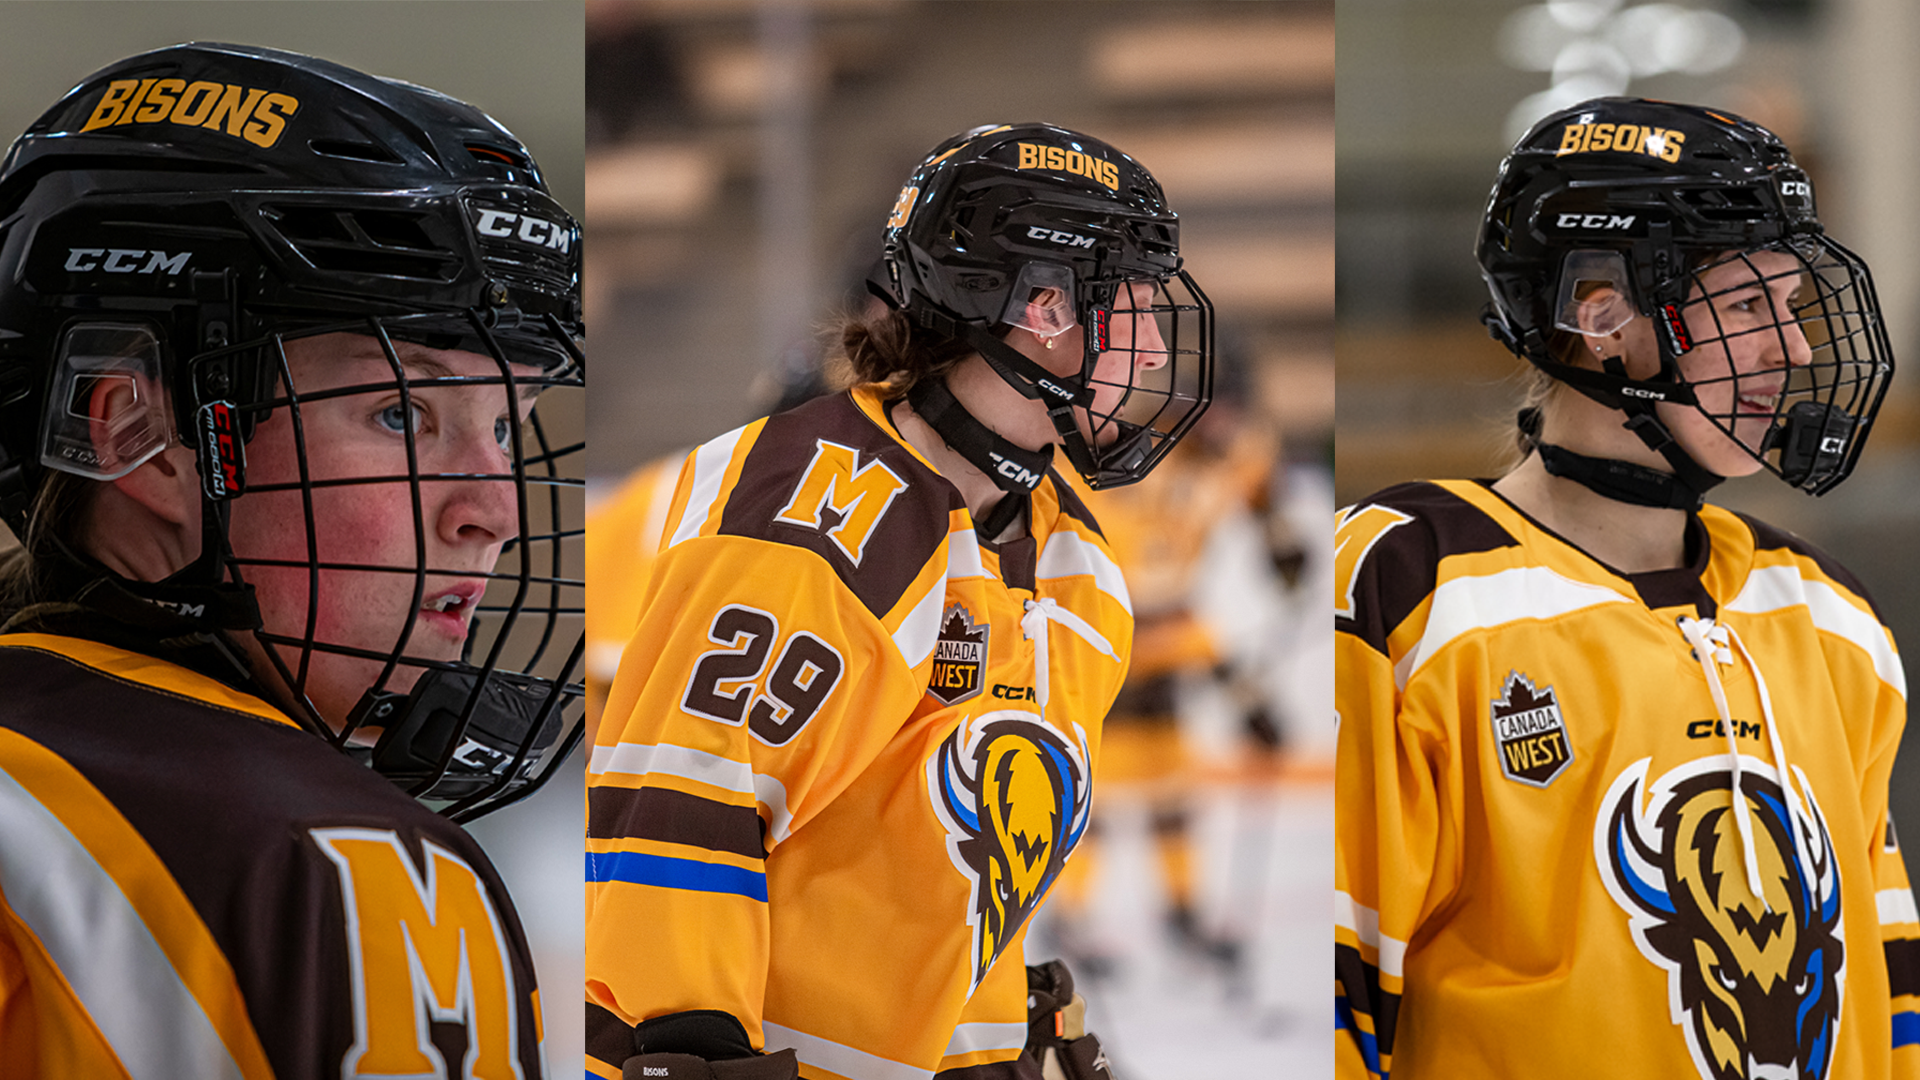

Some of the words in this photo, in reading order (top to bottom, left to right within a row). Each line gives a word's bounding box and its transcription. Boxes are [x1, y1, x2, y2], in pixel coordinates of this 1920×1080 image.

[78, 78, 299, 149] BISONS
[1555, 123, 1686, 164] BISONS
[1017, 142, 1120, 191] BISONS
[476, 208, 571, 254] CCM
[1026, 225, 1097, 249] CCM
[1556, 213, 1636, 230] CCM
[63, 248, 193, 275] CCM
[1097, 309, 1106, 351] CCM
[1665, 304, 1690, 350] CCM
[1038, 378, 1075, 400] CCM
[1621, 387, 1666, 400] CCM
[214, 403, 240, 491] CCM
[773, 438, 910, 569] M
[933, 641, 979, 661] ANADA
[680, 603, 845, 747] 29
[1499, 708, 1558, 739] CANADA
[1686, 719, 1761, 741] CCM
[1505, 732, 1563, 773] WEST
[308, 826, 525, 1080] M
[643, 1066, 669, 1077] BISONS
